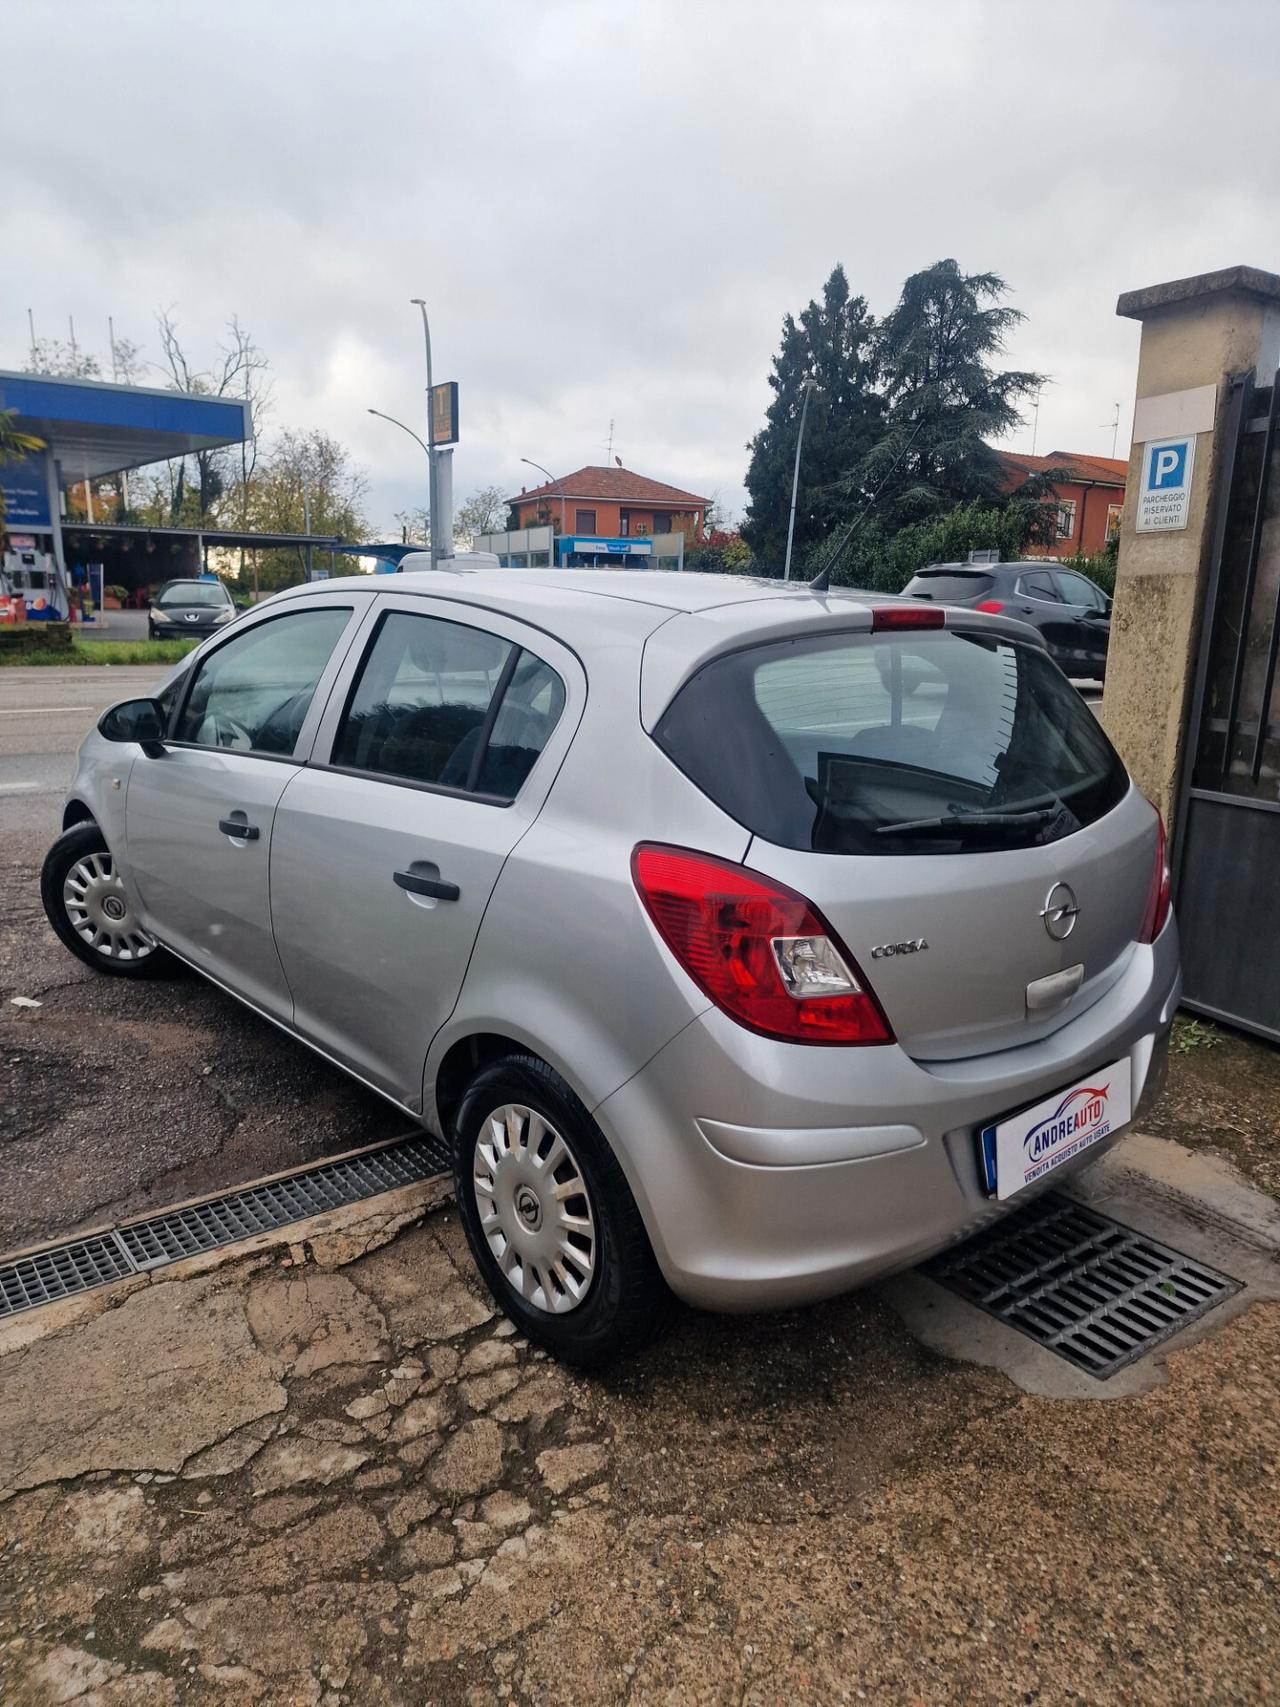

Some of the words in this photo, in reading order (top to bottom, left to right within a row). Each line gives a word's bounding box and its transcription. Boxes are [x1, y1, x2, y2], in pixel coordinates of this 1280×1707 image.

[1155, 450, 1179, 486] P
[1143, 492, 1185, 504] PARCHEGGIO
[1144, 504, 1182, 515] RISERVATO
[1153, 515, 1180, 525] CLIENTI
[871, 938, 929, 958] CORSA
[1034, 1099, 1101, 1156] ANDREAUTO
[1024, 1161, 1050, 1183] VENDITA
[1050, 1144, 1079, 1166] ACQUISTO
[1079, 1135, 1093, 1151] AUTO
[1093, 1123, 1111, 1141] USATE
